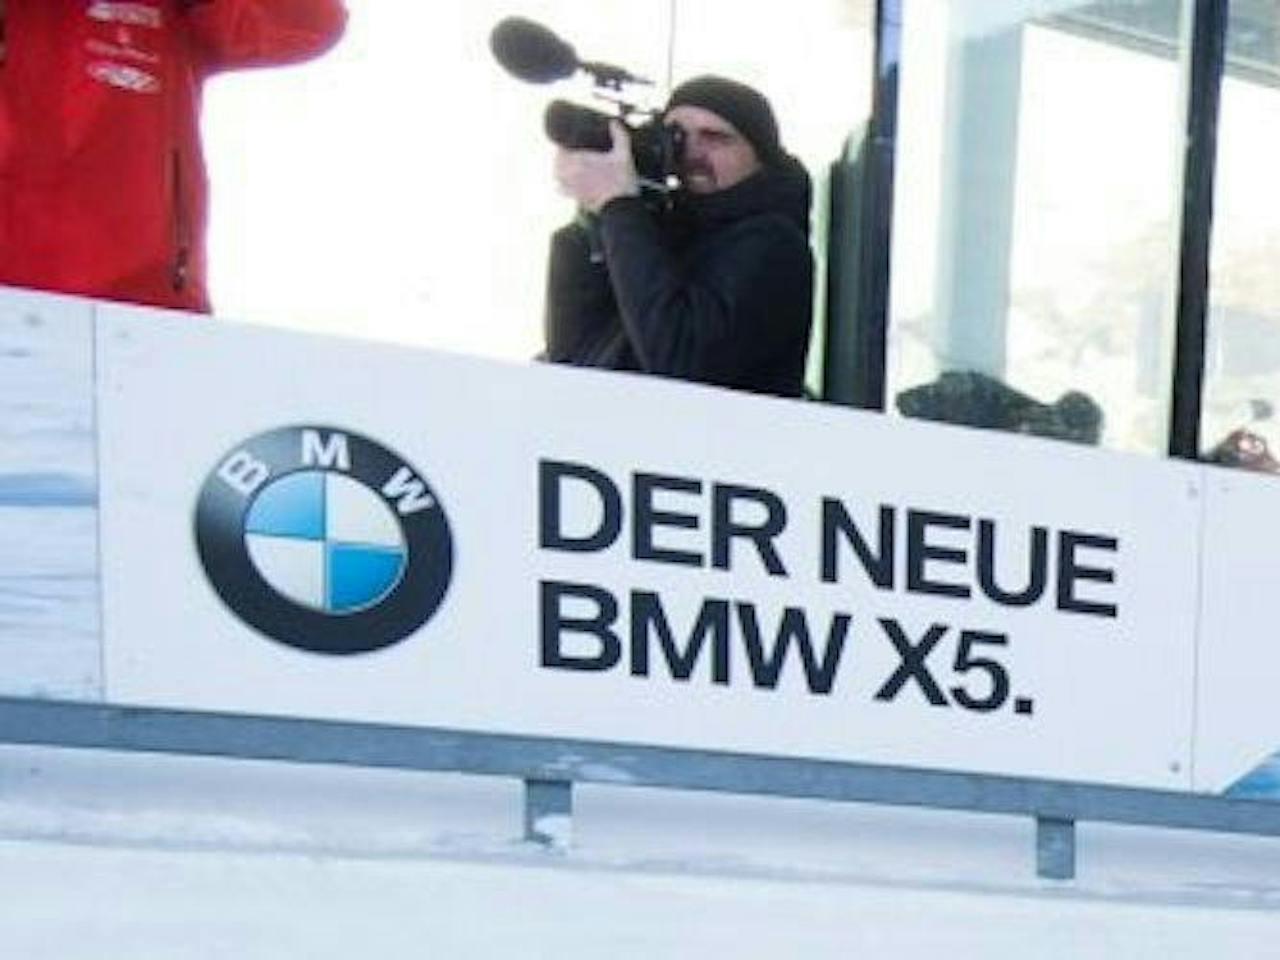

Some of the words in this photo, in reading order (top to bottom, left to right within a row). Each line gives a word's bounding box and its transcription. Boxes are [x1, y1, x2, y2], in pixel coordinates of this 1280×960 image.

[218, 430, 435, 516] BMW
[538, 459, 788, 577] DER
[820, 498, 1118, 618] NEUE
[538, 580, 852, 694] BMW
[873, 618, 1033, 715] X5.
